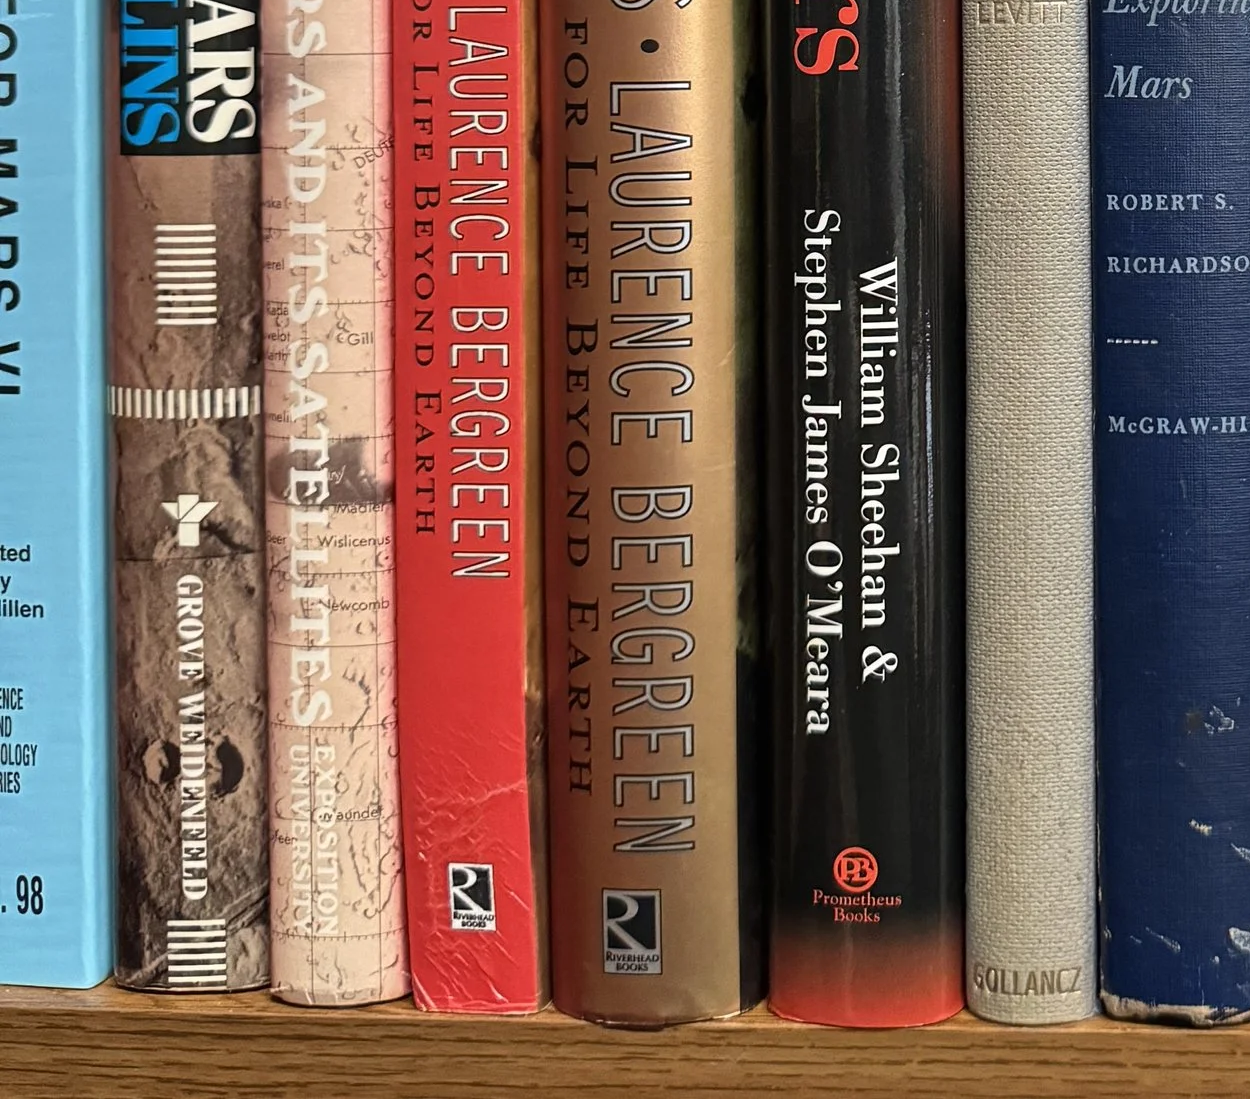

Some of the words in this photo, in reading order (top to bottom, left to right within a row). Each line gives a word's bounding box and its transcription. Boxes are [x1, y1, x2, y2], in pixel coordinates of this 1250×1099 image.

[563, 18, 590, 132] FOR
[976, 0, 1067, 23] LEVITT
[286, 70, 326, 203] AND
[448, 5, 511, 276] LAURENCE
[1106, 65, 1194, 100] Mars
[609, 80, 694, 446] LAURENCE
[1106, 193, 1204, 211] ROBERT
[1214, 193, 1234, 211] S.
[288, 222, 329, 324] ITS
[792, 209, 842, 379] Stephen
[858, 259, 898, 427] William
[448, 306, 511, 581] BERGREEN
[802, 393, 843, 524] James
[288, 340, 333, 727] SATELLITES
[317, 533, 392, 548] Wislicenus
[860, 443, 899, 627] Sheehan
[174, 573, 204, 680] GROVE
[608, 484, 696, 853] BERGREEN
[804, 540, 843, 735] O'Meara
[861, 645, 898, 682] &
[177, 693, 208, 900] WEIDENFELD
[290, 745, 311, 935] UNIVERSITY
[315, 745, 339, 934] EXPOSITION
[16, 875, 44, 915] 98
[813, 889, 902, 906] Prometheus
[834, 907, 880, 922] Books
[616, 963, 648, 971] BOOKS
[974, 963, 1081, 995] GOLLANCZ
